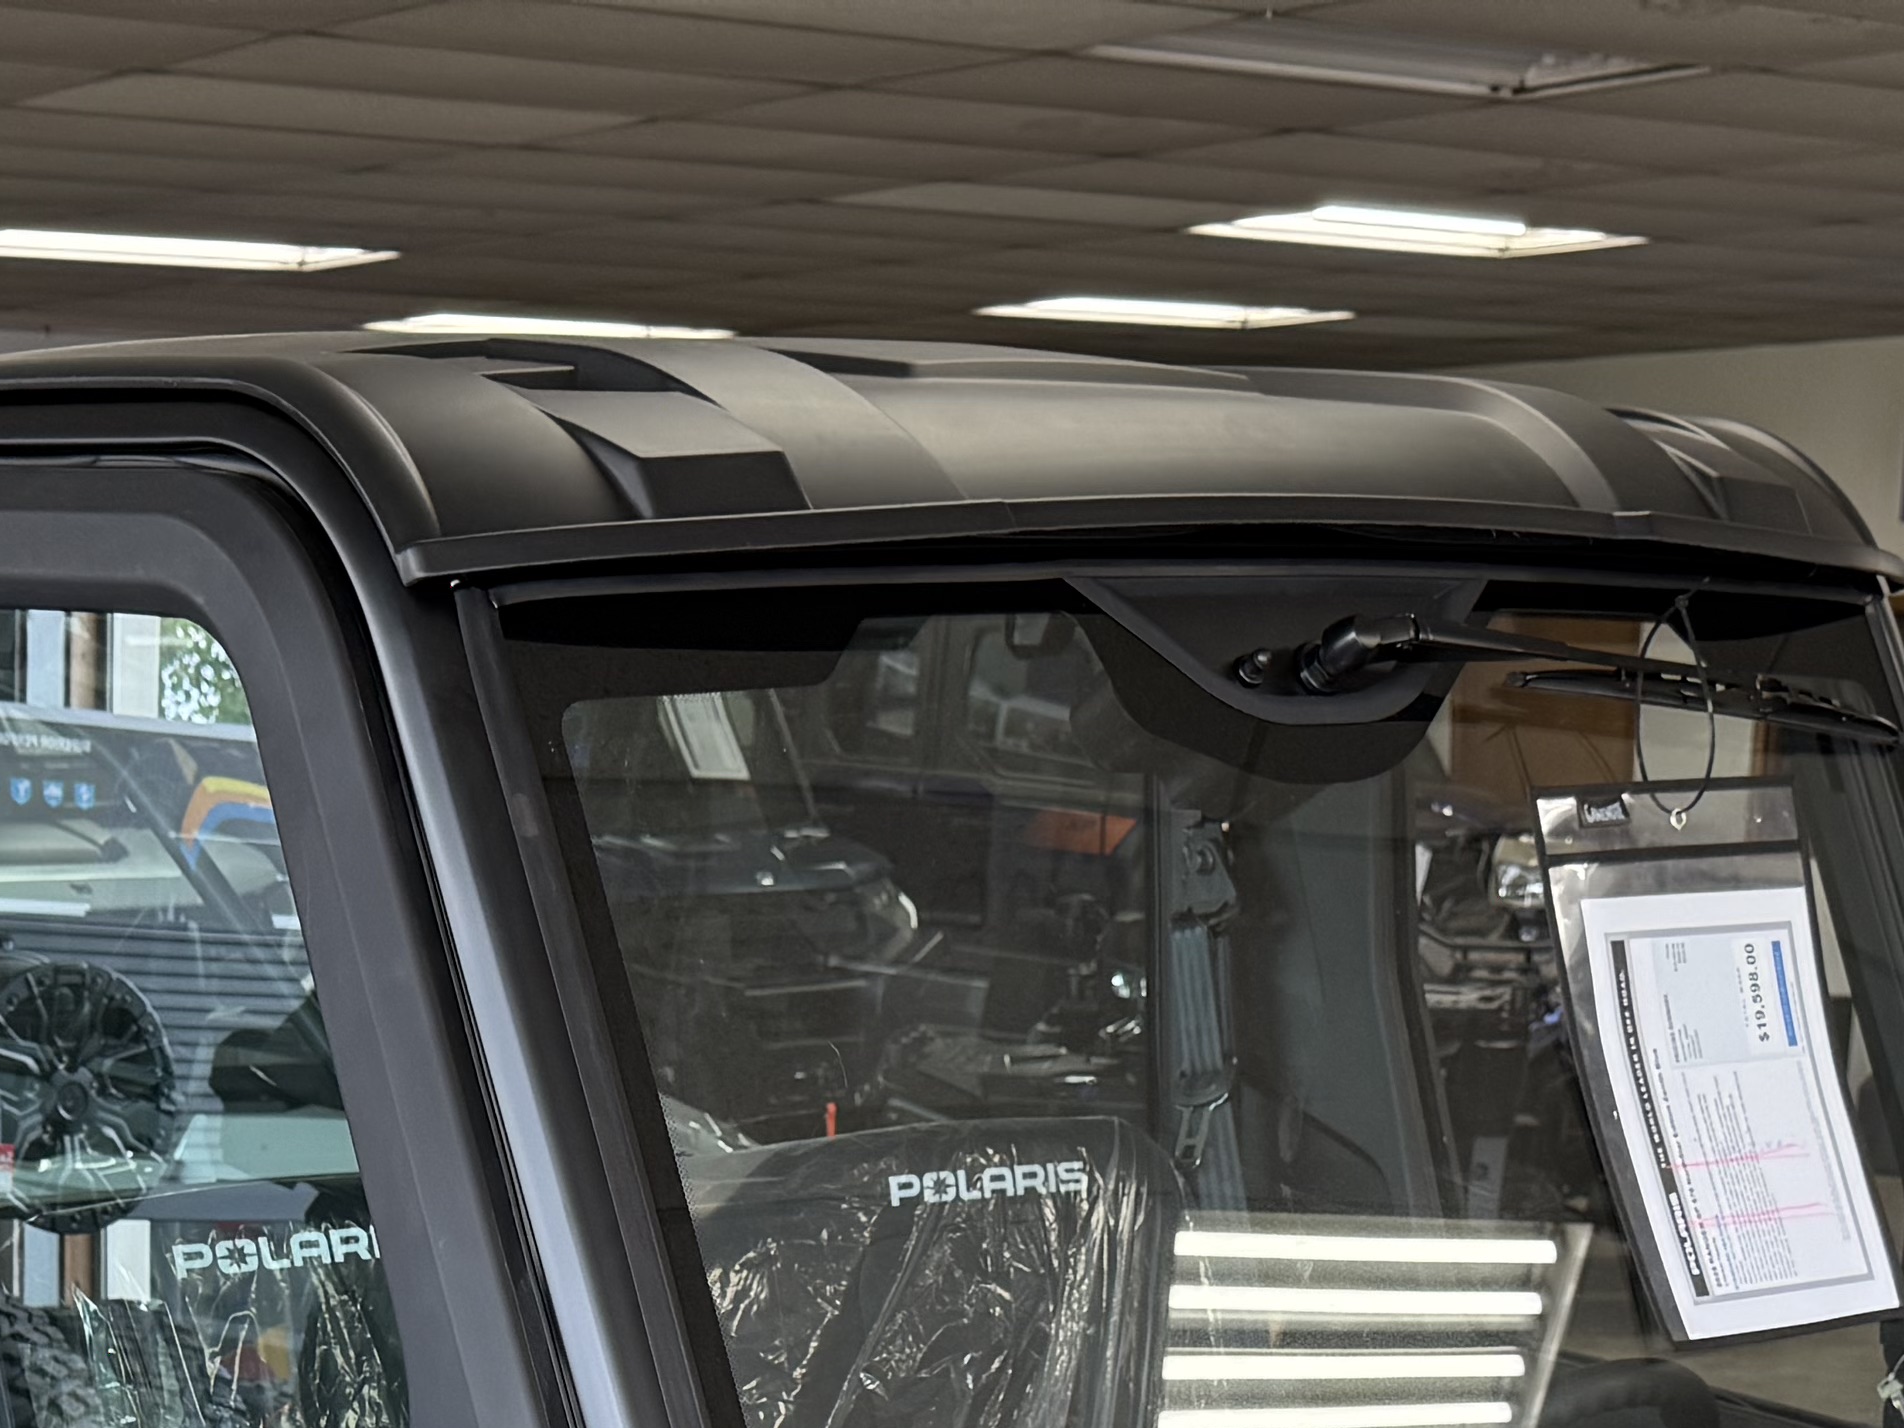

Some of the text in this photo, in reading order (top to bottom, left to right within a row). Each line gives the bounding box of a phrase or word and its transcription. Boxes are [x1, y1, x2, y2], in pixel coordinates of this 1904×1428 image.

[888, 1160, 1088, 1207] POLARIS
[171, 1223, 381, 1281] POLARI
[1668, 1192, 1701, 1276] POLARIS
